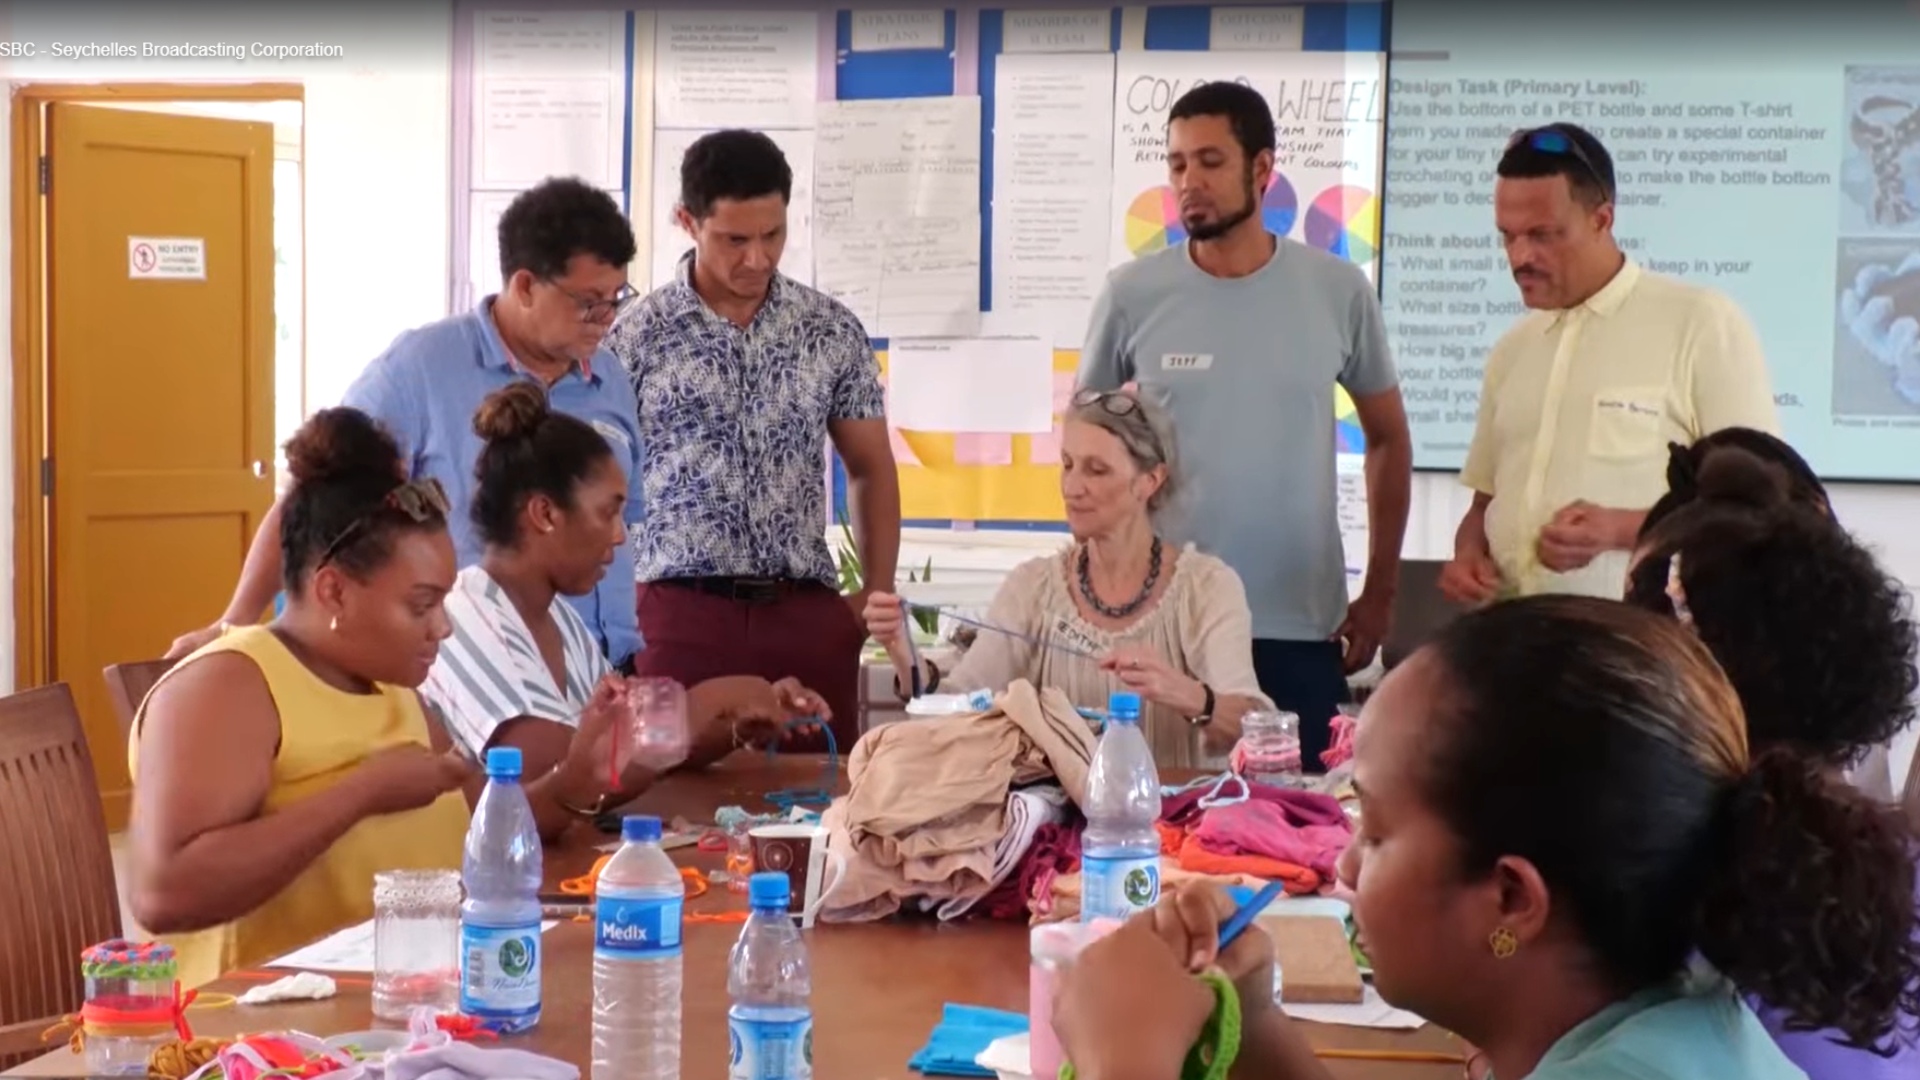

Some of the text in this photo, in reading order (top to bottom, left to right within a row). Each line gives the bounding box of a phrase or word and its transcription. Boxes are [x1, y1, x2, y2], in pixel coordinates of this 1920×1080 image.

[1389, 79, 1648, 99] Design Task (Primary Level):
[1279, 79, 1385, 122] WHEEL
[1389, 101, 1793, 118] Use the bottom of a PET bottle and some T-shirt
[1429, 127, 1460, 141] you
[1609, 125, 1663, 139] create
[1667, 129, 1678, 139] a
[1683, 124, 1743, 143] special
[1746, 125, 1826, 140] container
[1389, 148, 1408, 162] for
[1414, 151, 1450, 165] your
[1456, 147, 1486, 165] tiny
[1617, 147, 1787, 165] can try experimental
[1388, 168, 1473, 186] crocheting
[1638, 169, 1684, 184] make
[1689, 170, 1716, 184] the
[1720, 170, 1767, 185] bottle
[1772, 170, 1831, 185] bottom
[1387, 191, 1439, 208] bigger
[1443, 191, 1459, 205] to
[1386, 233, 1436, 249] Think
[1441, 232, 1492, 249] about
[1399, 256, 1444, 271] What
[1448, 256, 1493, 271] small
[1648, 258, 1752, 277] keep in your
[1399, 278, 1487, 293] container?
[1399, 300, 1443, 314] What
[1447, 301, 1481, 314] size
[1397, 320, 1487, 336] treasures?
[1440, 343, 1466, 362] big
[1398, 368, 1434, 383] your
[602, 921, 648, 941] Medix
